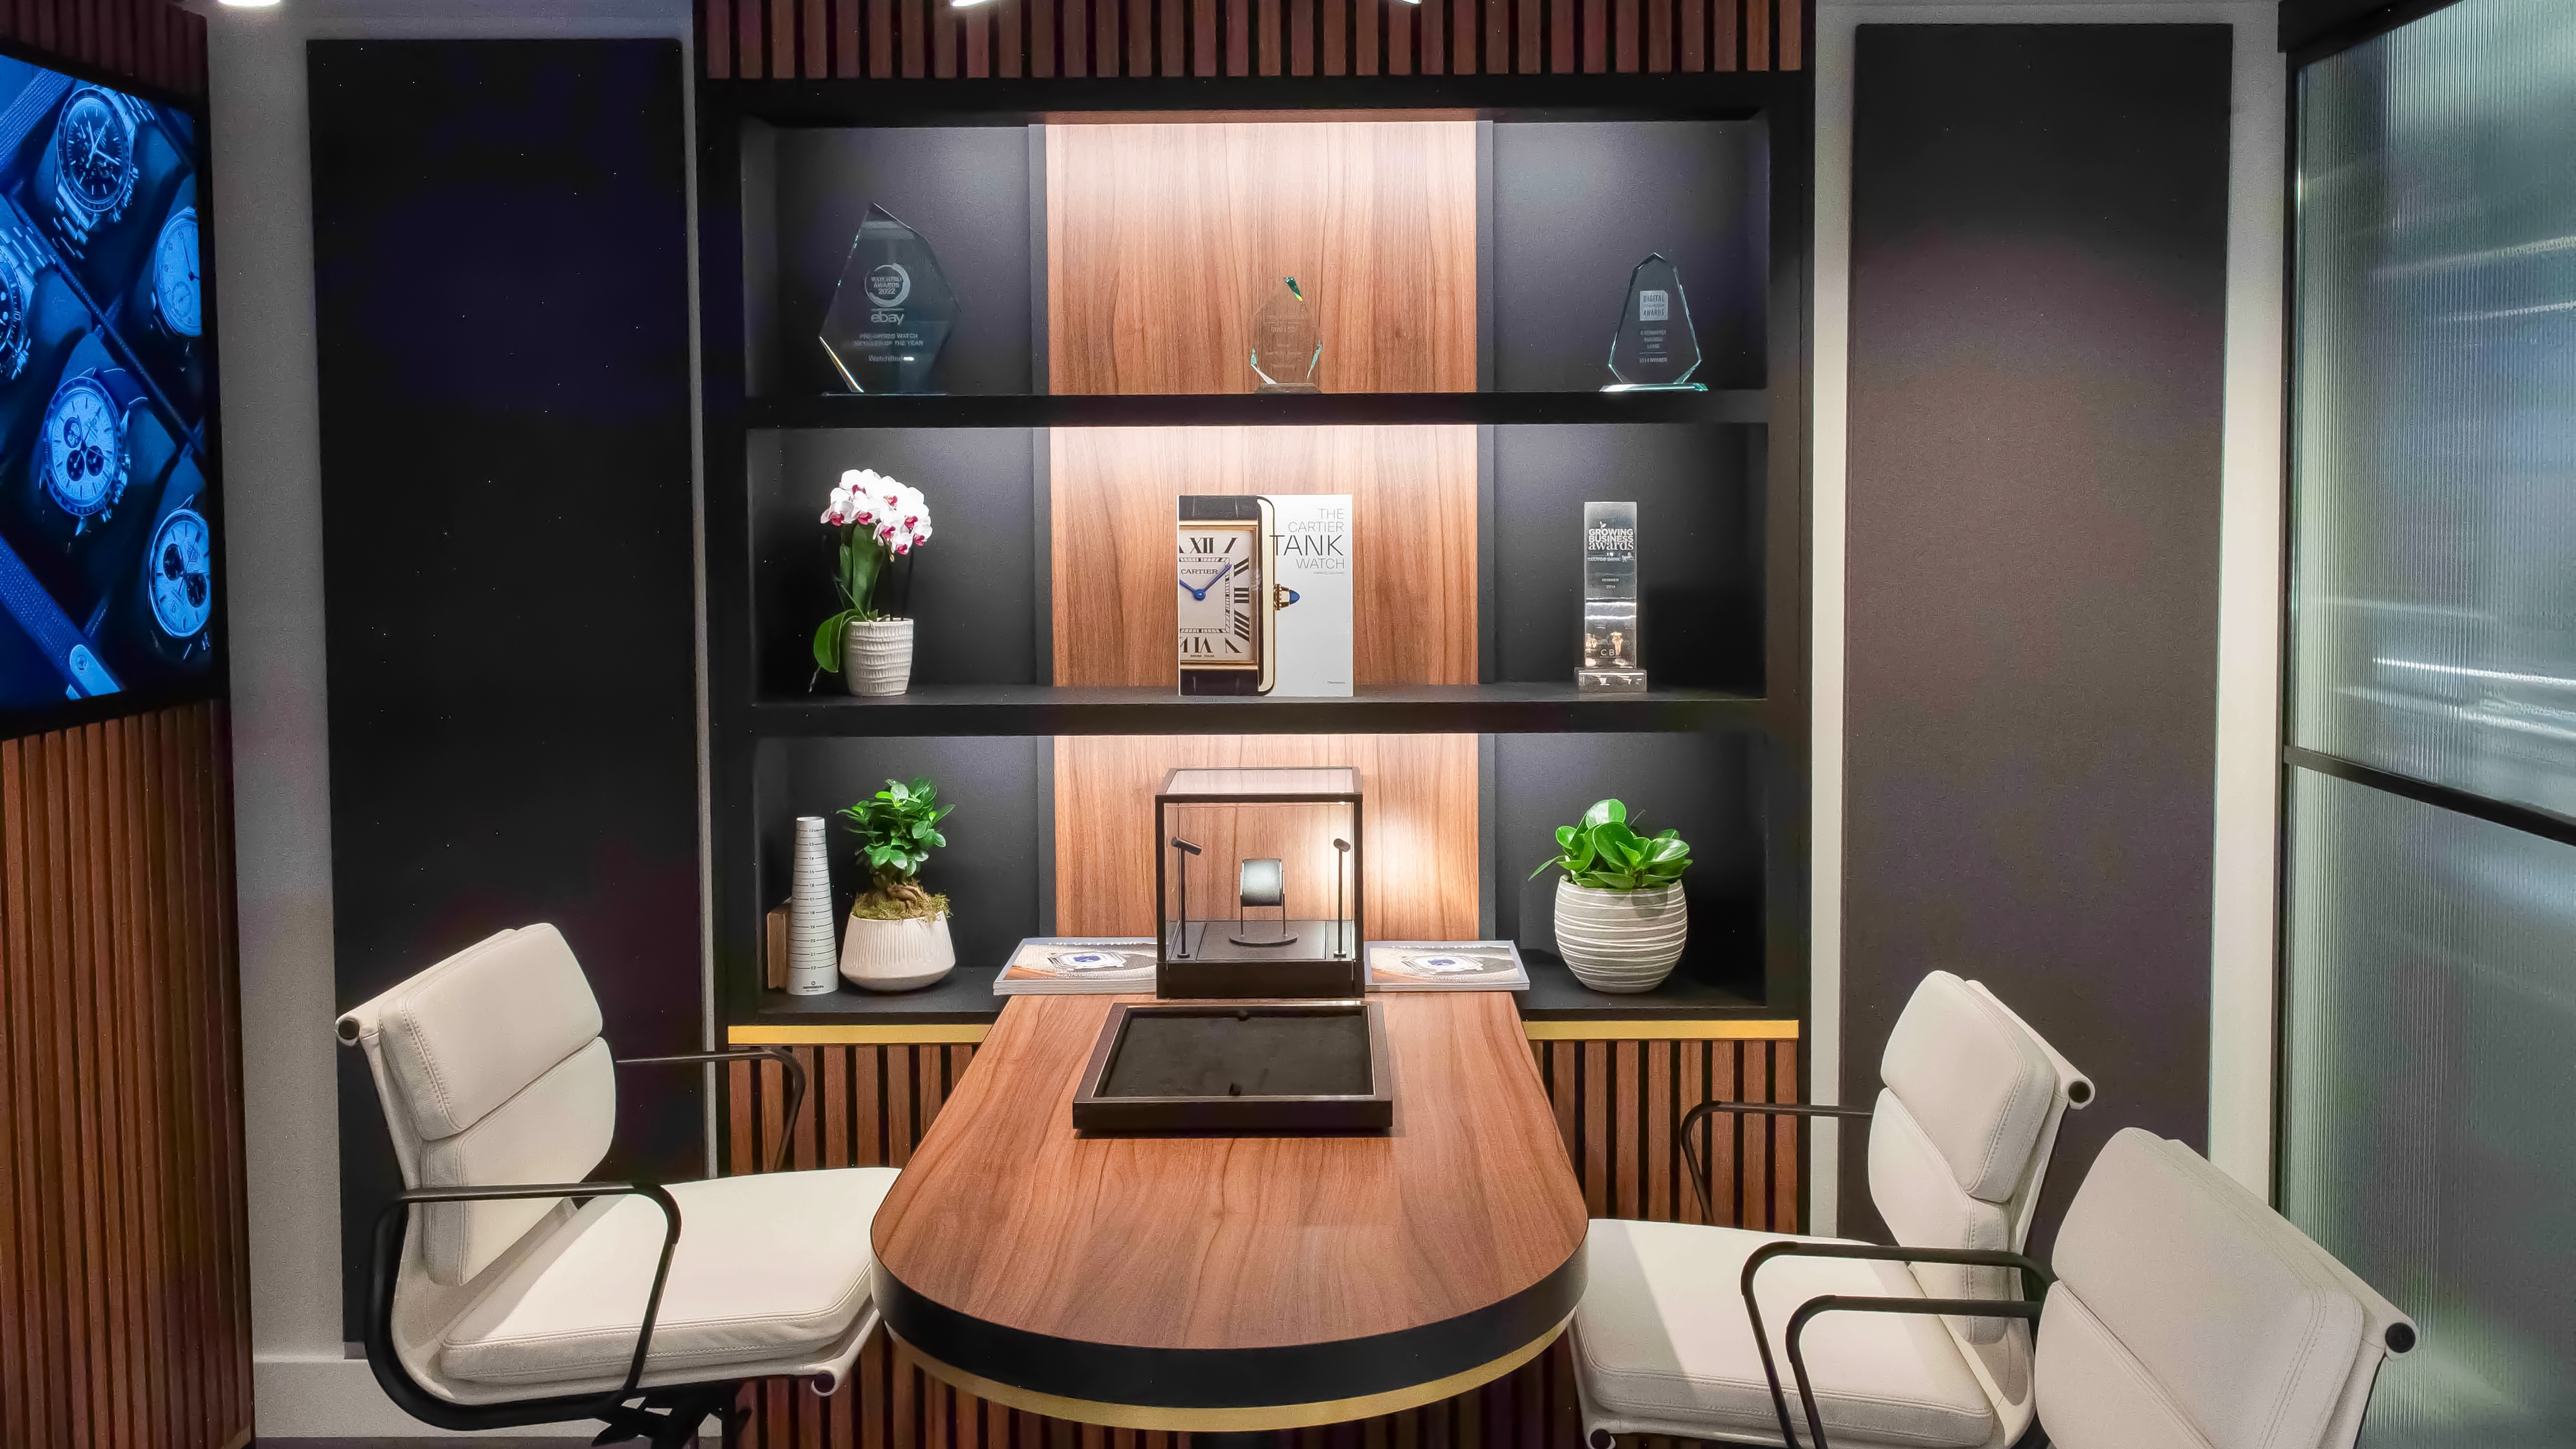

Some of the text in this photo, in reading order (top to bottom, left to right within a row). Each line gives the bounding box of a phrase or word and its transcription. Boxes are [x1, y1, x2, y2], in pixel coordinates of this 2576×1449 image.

[1643, 294, 1665, 303] DIGITAL
[870, 311, 904, 325] ebay
[1318, 508, 1344, 519] THE
[1288, 521, 1344, 533] CARTIER
[1269, 535, 1344, 556] TANK
[1588, 540, 1634, 551] awards
[1296, 558, 1345, 569] WATCH
